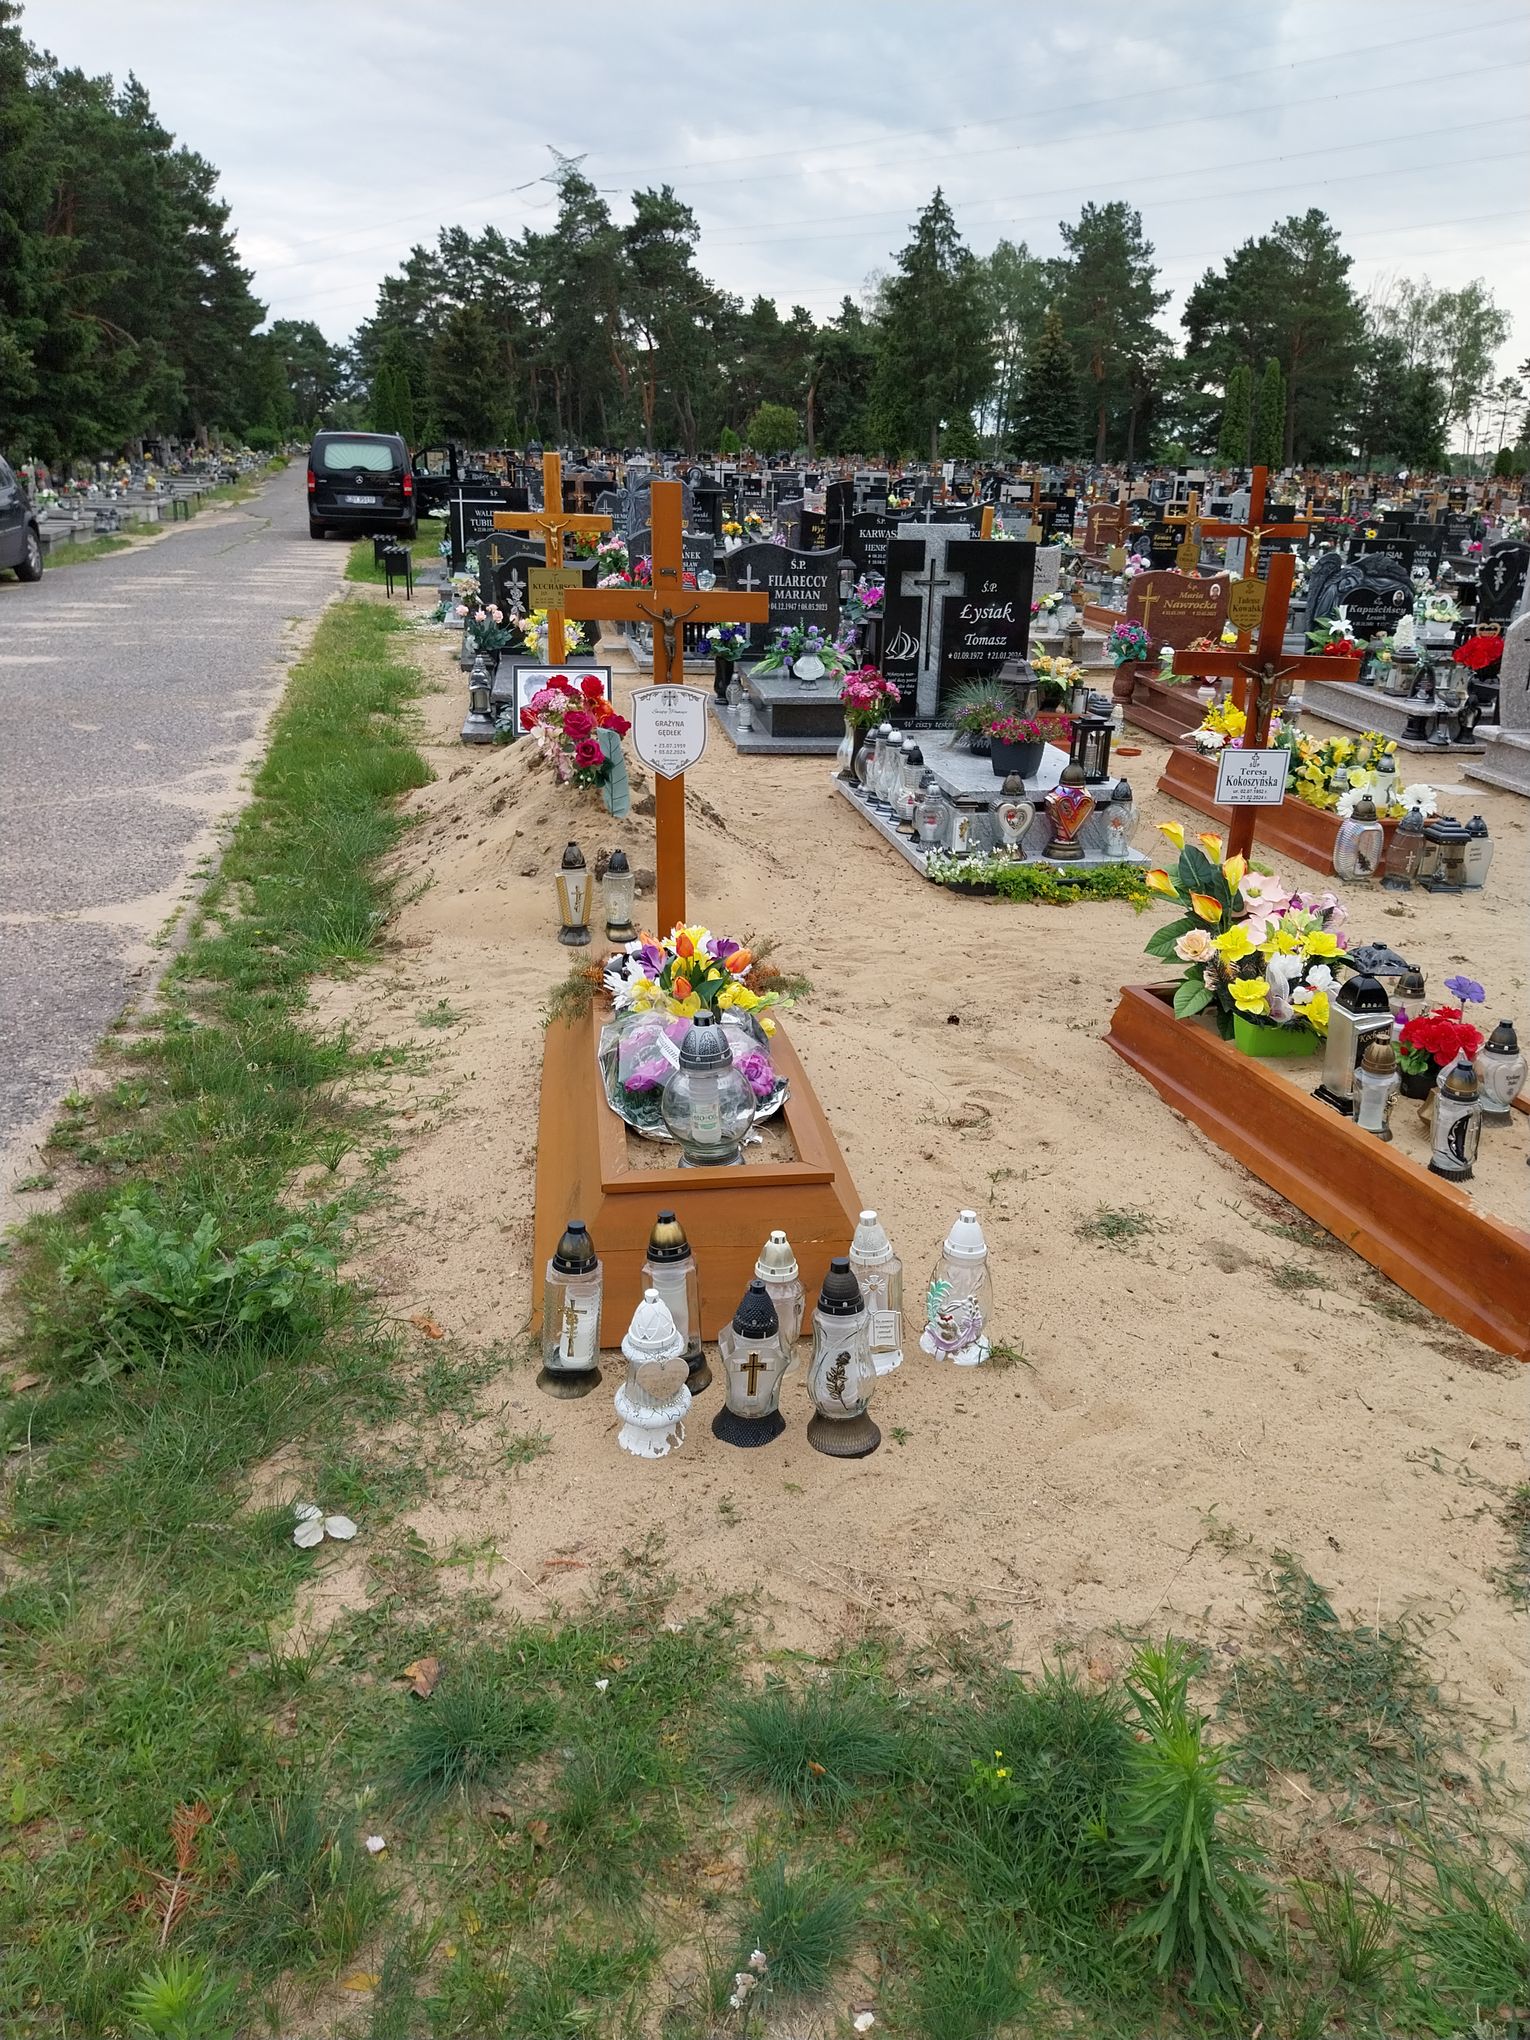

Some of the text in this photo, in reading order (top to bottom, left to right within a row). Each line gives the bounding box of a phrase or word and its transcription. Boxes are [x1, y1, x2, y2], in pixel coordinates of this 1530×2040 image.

[859, 529, 898, 539] KARWAS
[864, 544, 887, 552] HENR
[790, 558, 807, 570] Ś.P.
[768, 575, 828, 588] FILARECCY
[981, 580, 998, 593] Ś.P.
[774, 590, 821, 600] MARIAN
[1179, 591, 1204, 600] Maria
[1163, 600, 1217, 610] Nawrocka
[960, 602, 1016, 625] Łysiak
[964, 632, 1008, 647] Tomasz
[1226, 775, 1278, 788] Kokoszyńska
